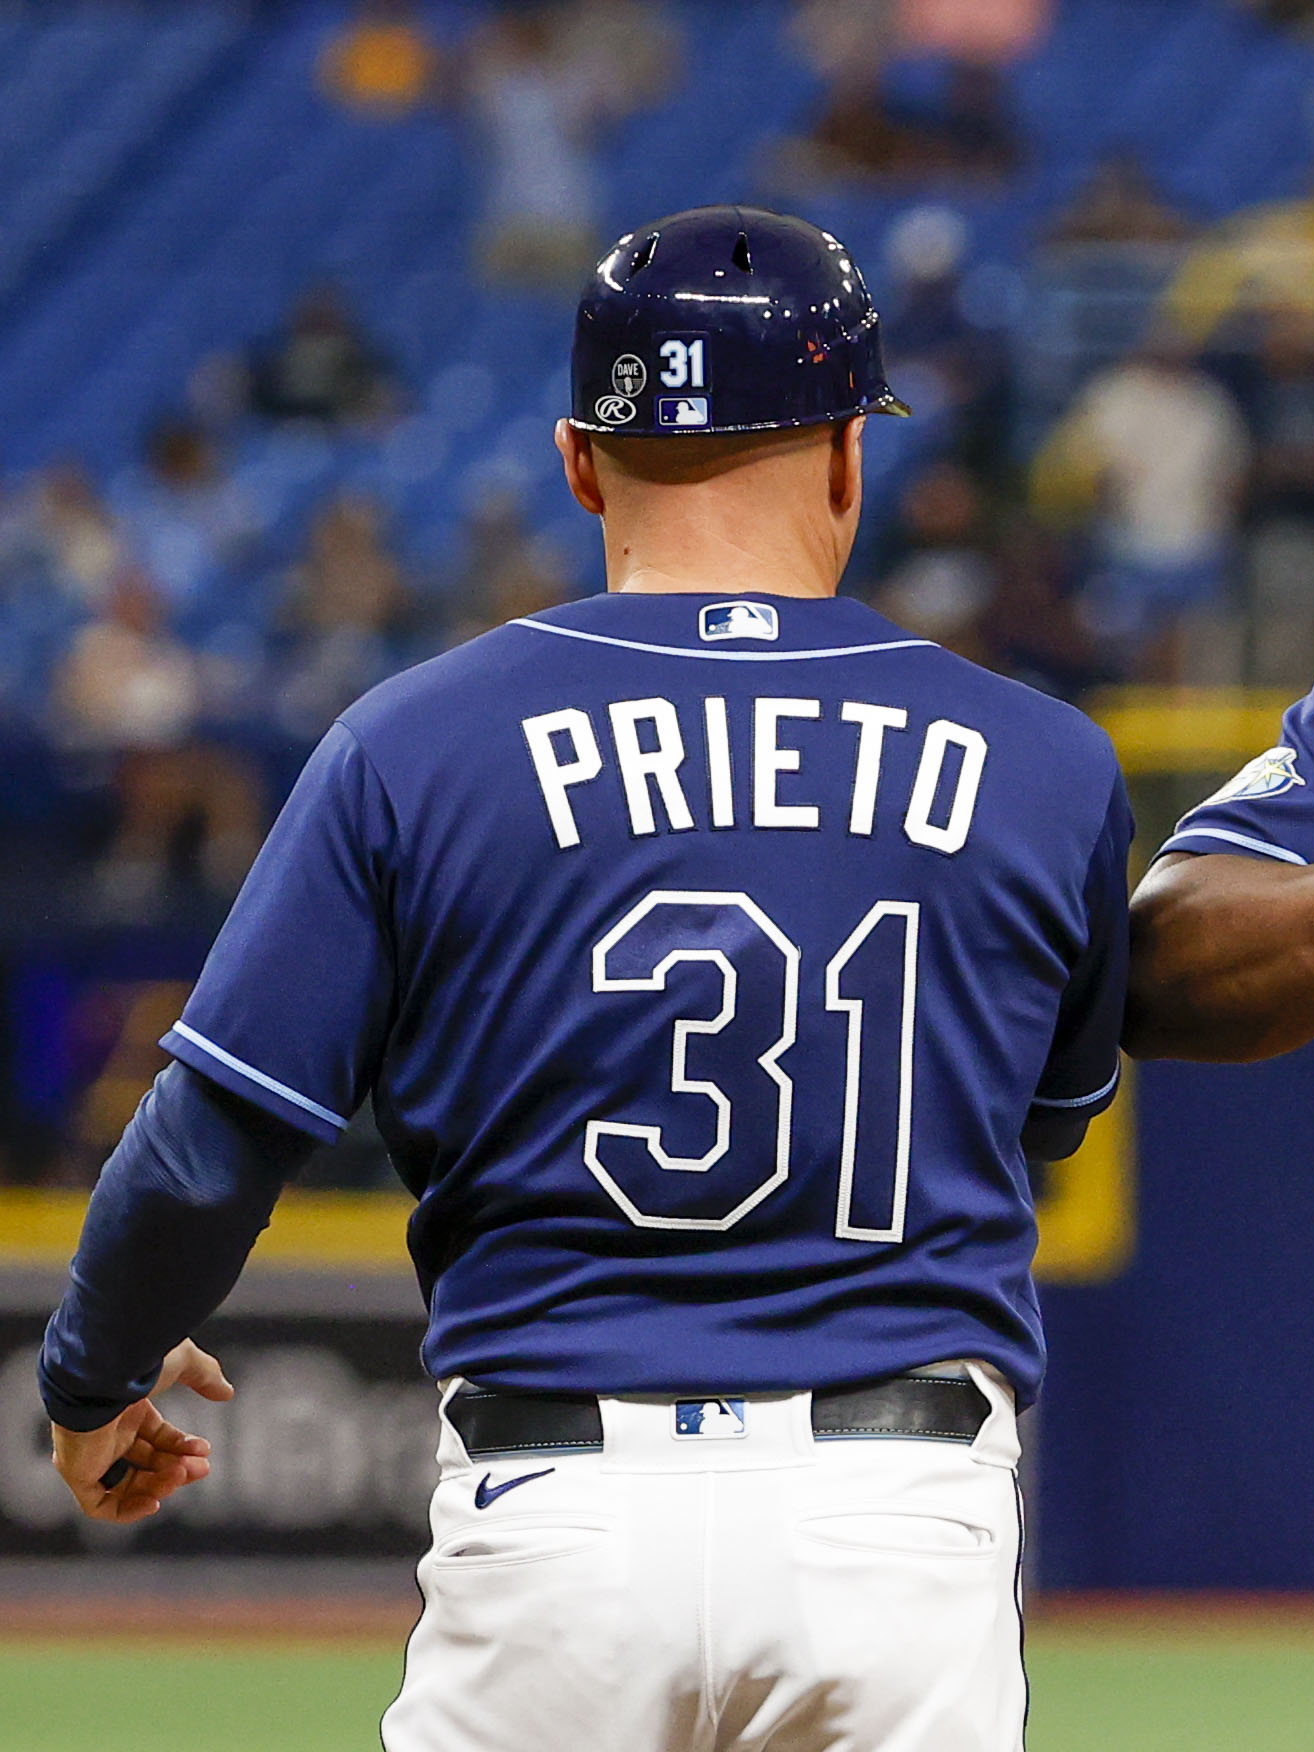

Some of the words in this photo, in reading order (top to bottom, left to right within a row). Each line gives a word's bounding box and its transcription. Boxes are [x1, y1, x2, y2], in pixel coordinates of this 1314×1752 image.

[617, 363, 639, 376] DAVE
[660, 339, 704, 388] 31
[520, 696, 988, 854] PRIETO
[583, 890, 920, 1243] 31
